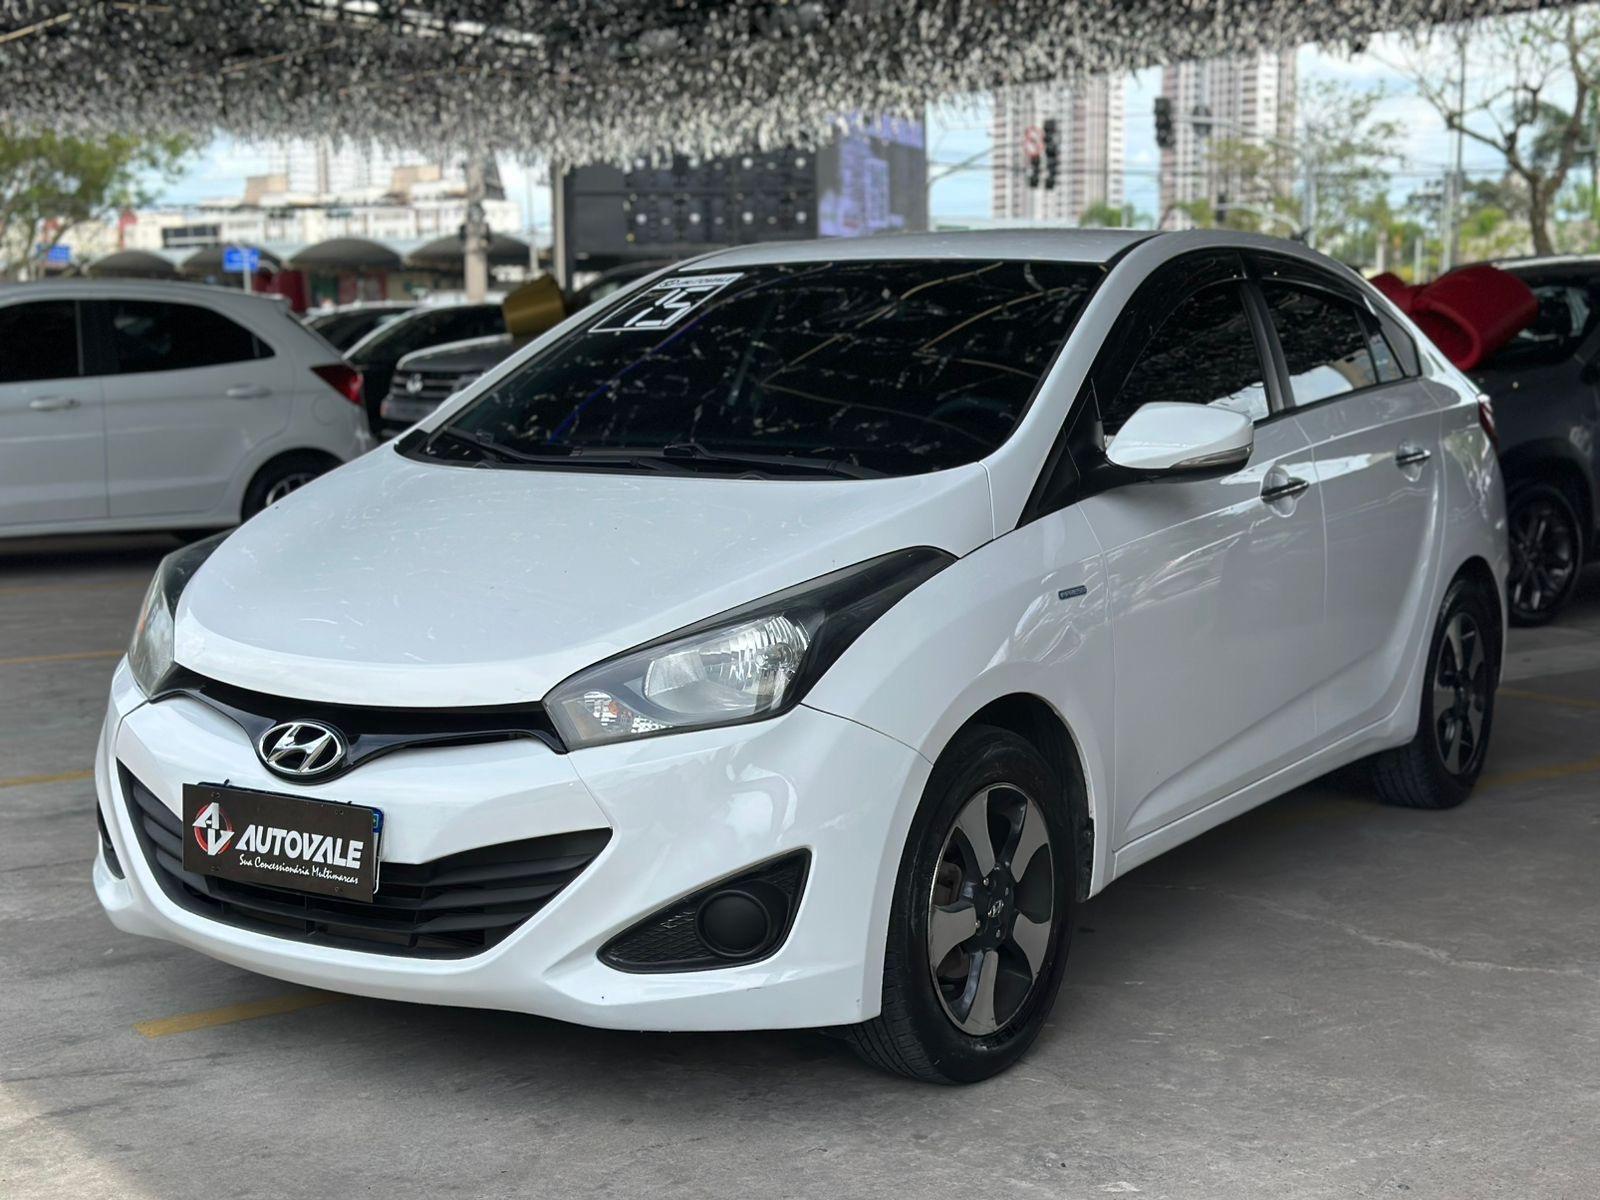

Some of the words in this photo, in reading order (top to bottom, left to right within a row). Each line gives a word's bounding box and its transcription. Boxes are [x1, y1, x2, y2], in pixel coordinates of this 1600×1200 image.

[235, 824, 364, 869] AUTOVALE
[239, 853, 253, 866] Sua
[311, 865, 359, 885] Multimarcas
